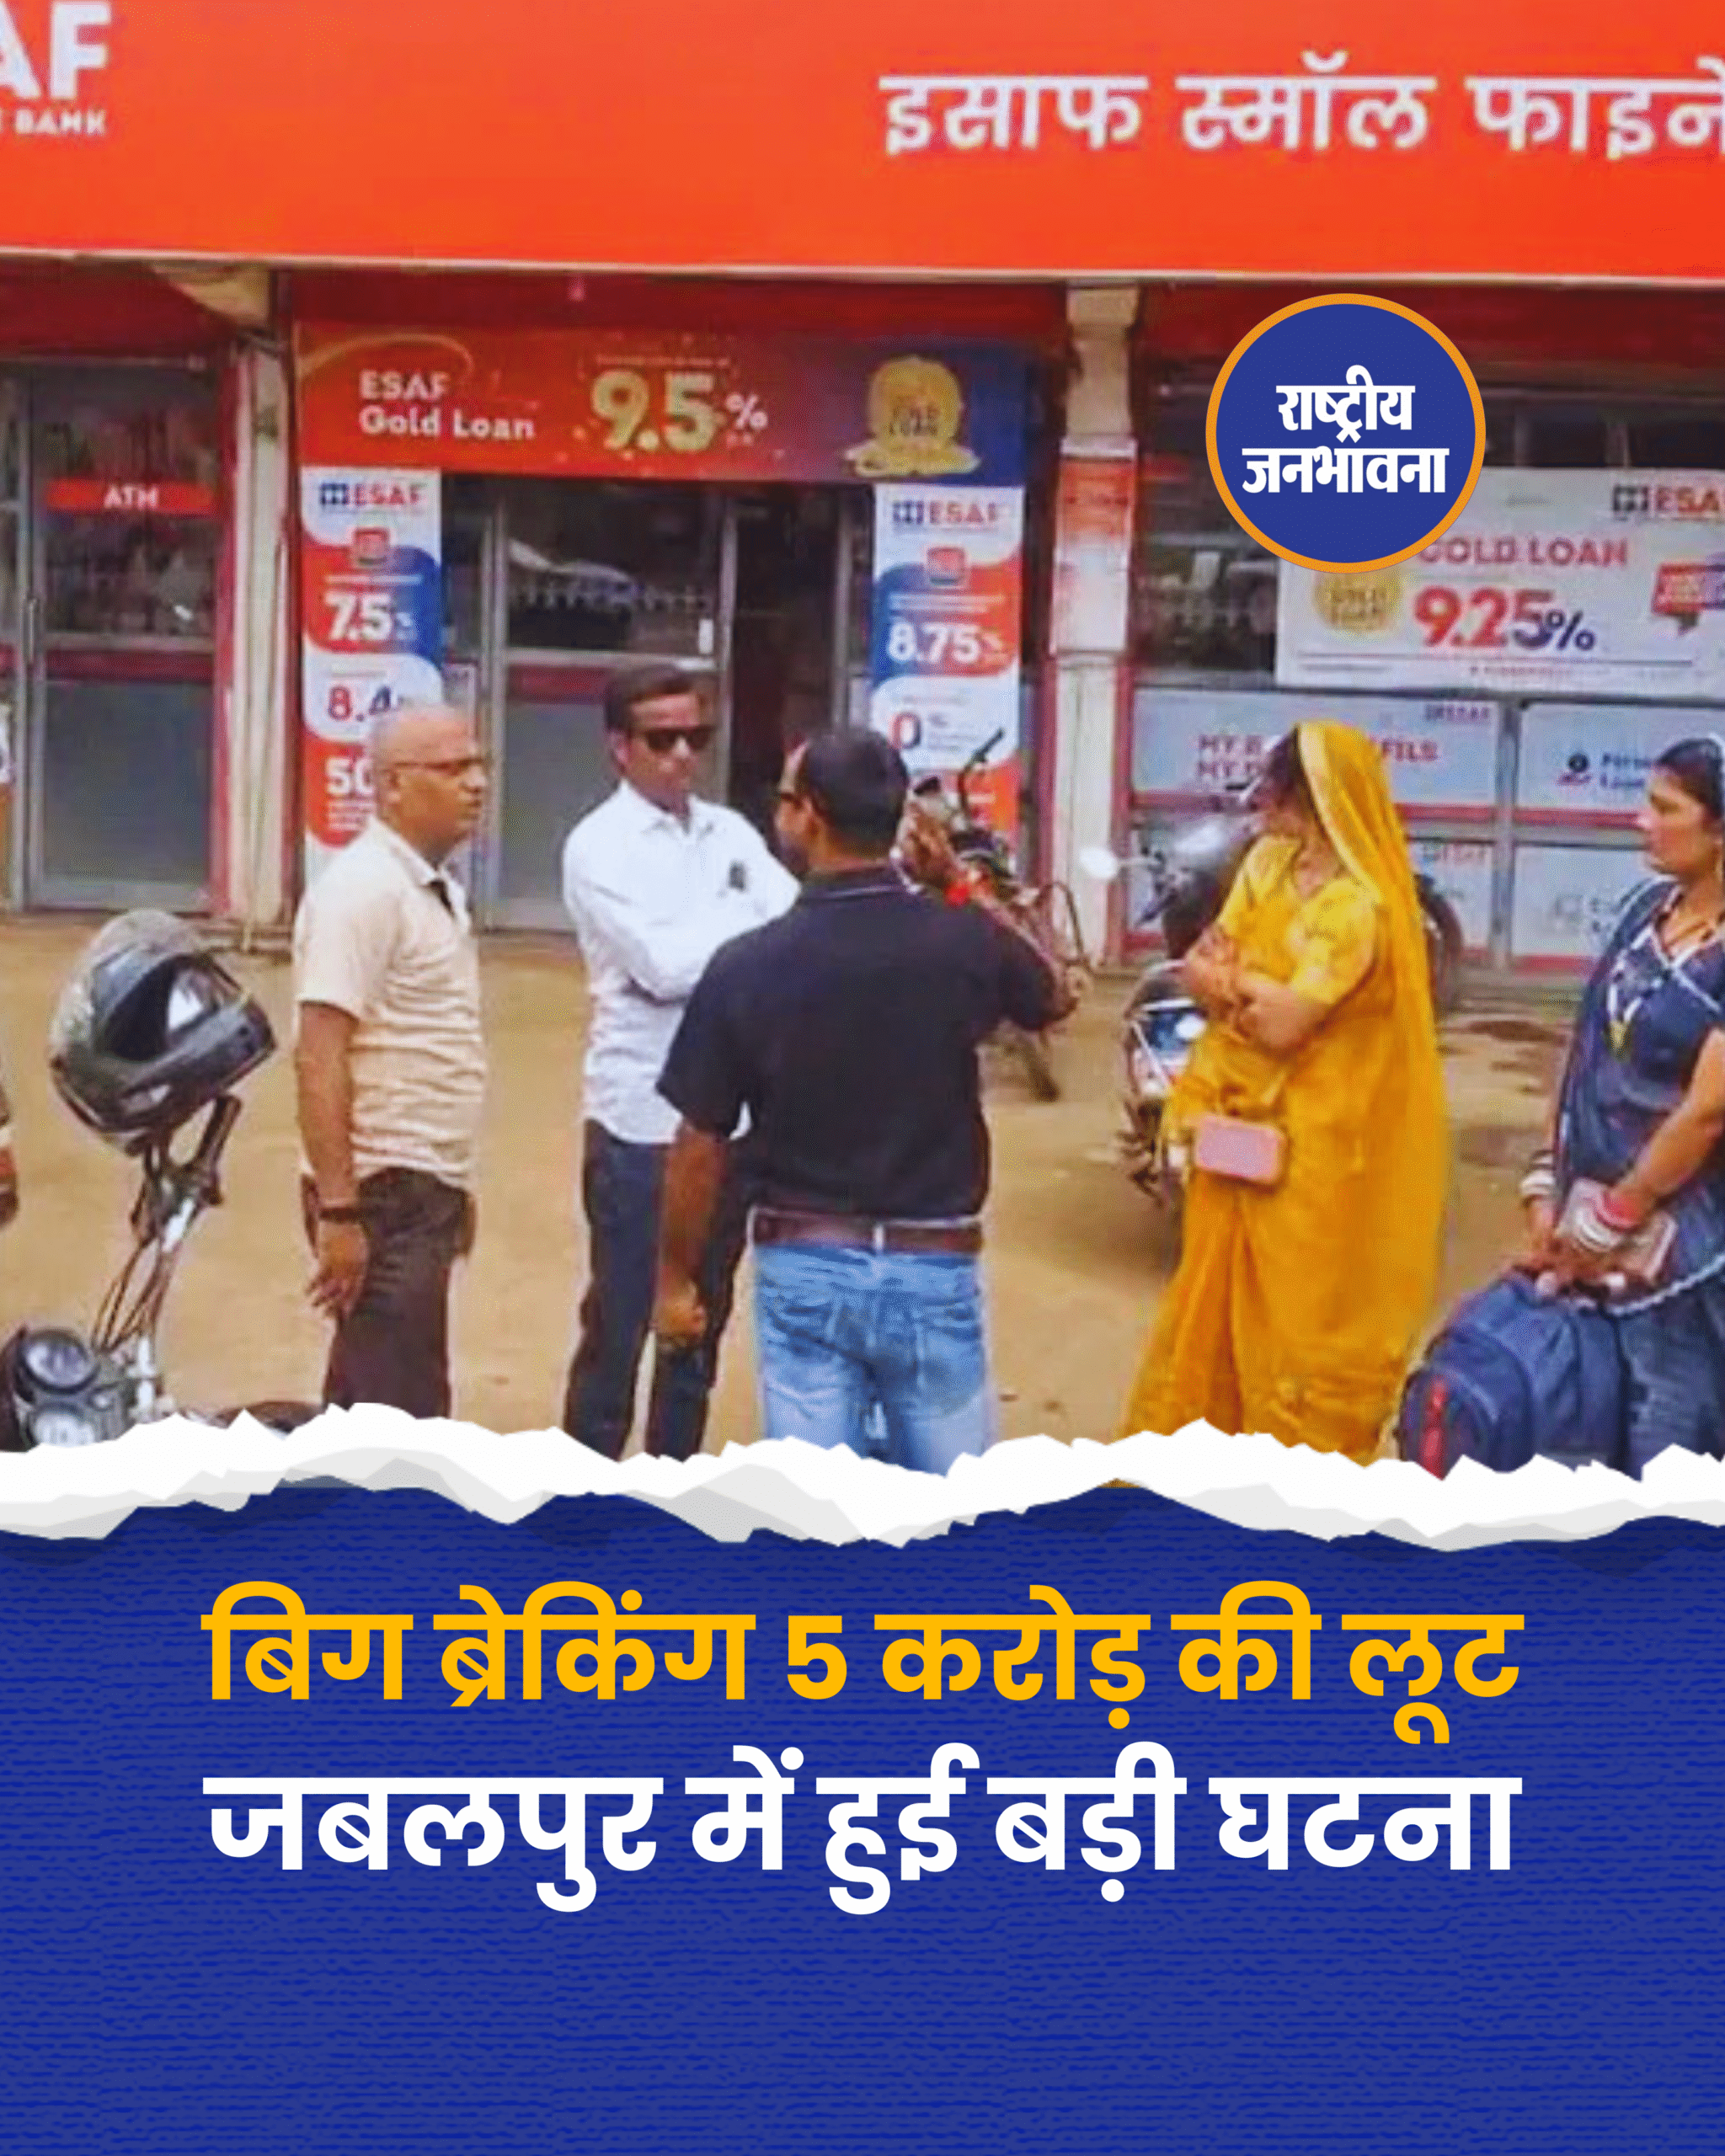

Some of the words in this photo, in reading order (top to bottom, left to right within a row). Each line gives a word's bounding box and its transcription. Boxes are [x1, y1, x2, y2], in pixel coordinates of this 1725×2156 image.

[879, 75, 1149, 155] इसाफ
[1175, 51, 1437, 149] स्मॉल
[15, 109, 106, 135] BANK
[360, 369, 450, 400] ESAF
[359, 404, 441, 437] Gold
[452, 408, 536, 441] Loan
[104, 483, 159, 510] ATM
[355, 483, 427, 506] ESAF
[1529, 538, 1626, 568] LOAN
